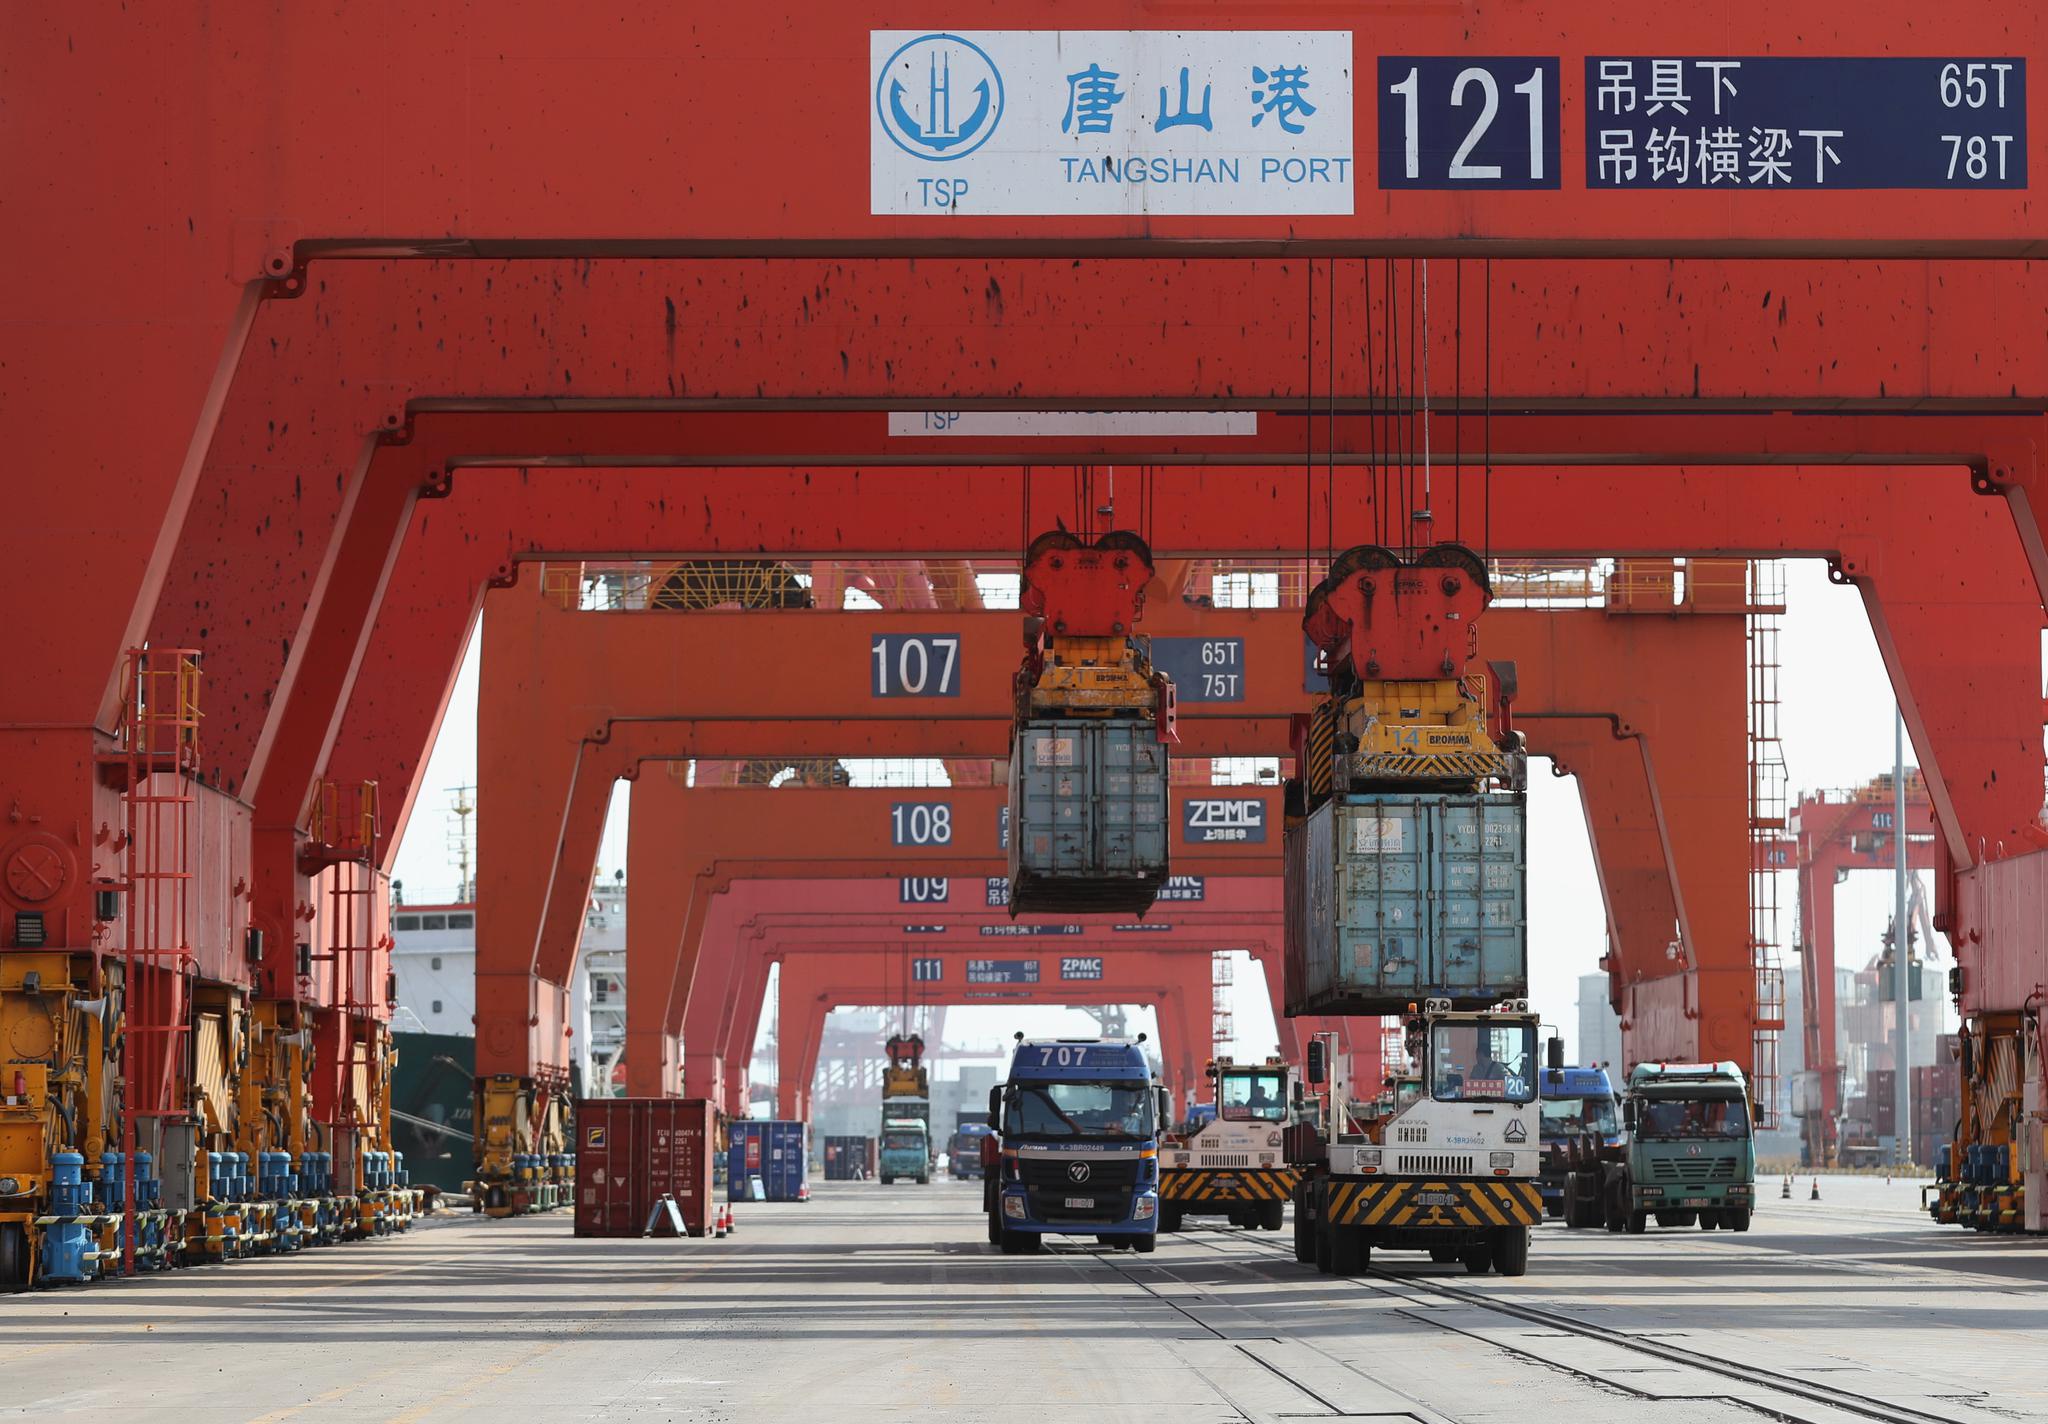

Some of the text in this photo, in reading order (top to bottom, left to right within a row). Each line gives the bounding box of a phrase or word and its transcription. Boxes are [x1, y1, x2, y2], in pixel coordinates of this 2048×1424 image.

[1598, 60, 1741, 116] 吊具下
[1940, 63, 2013, 108] 65T
[1061, 63, 1317, 135] 唐山港
[1390, 67, 1544, 180] 121
[1599, 126, 1844, 185] 吊钩横梁下
[1941, 135, 2013, 180] 78T
[1060, 158, 1351, 184] TANGSHAN PORT
[917, 178, 968, 207] TSP
[872, 639, 958, 694] 107
[1202, 642, 1238, 665] 65T
[1202, 675, 1238, 697] 75T
[1393, 730, 1419, 747] 14
[1429, 735, 1470, 745] BROMMA
[892, 805, 951, 843] 108
[1188, 800, 1261, 827] ZPMC
[1872, 813, 1892, 828] 41t
[914, 960, 942, 980] 111
[1062, 958, 1101, 970] ZPMC
[1040, 1047, 1087, 1066] 707
[1508, 1079, 1524, 1096] 20
